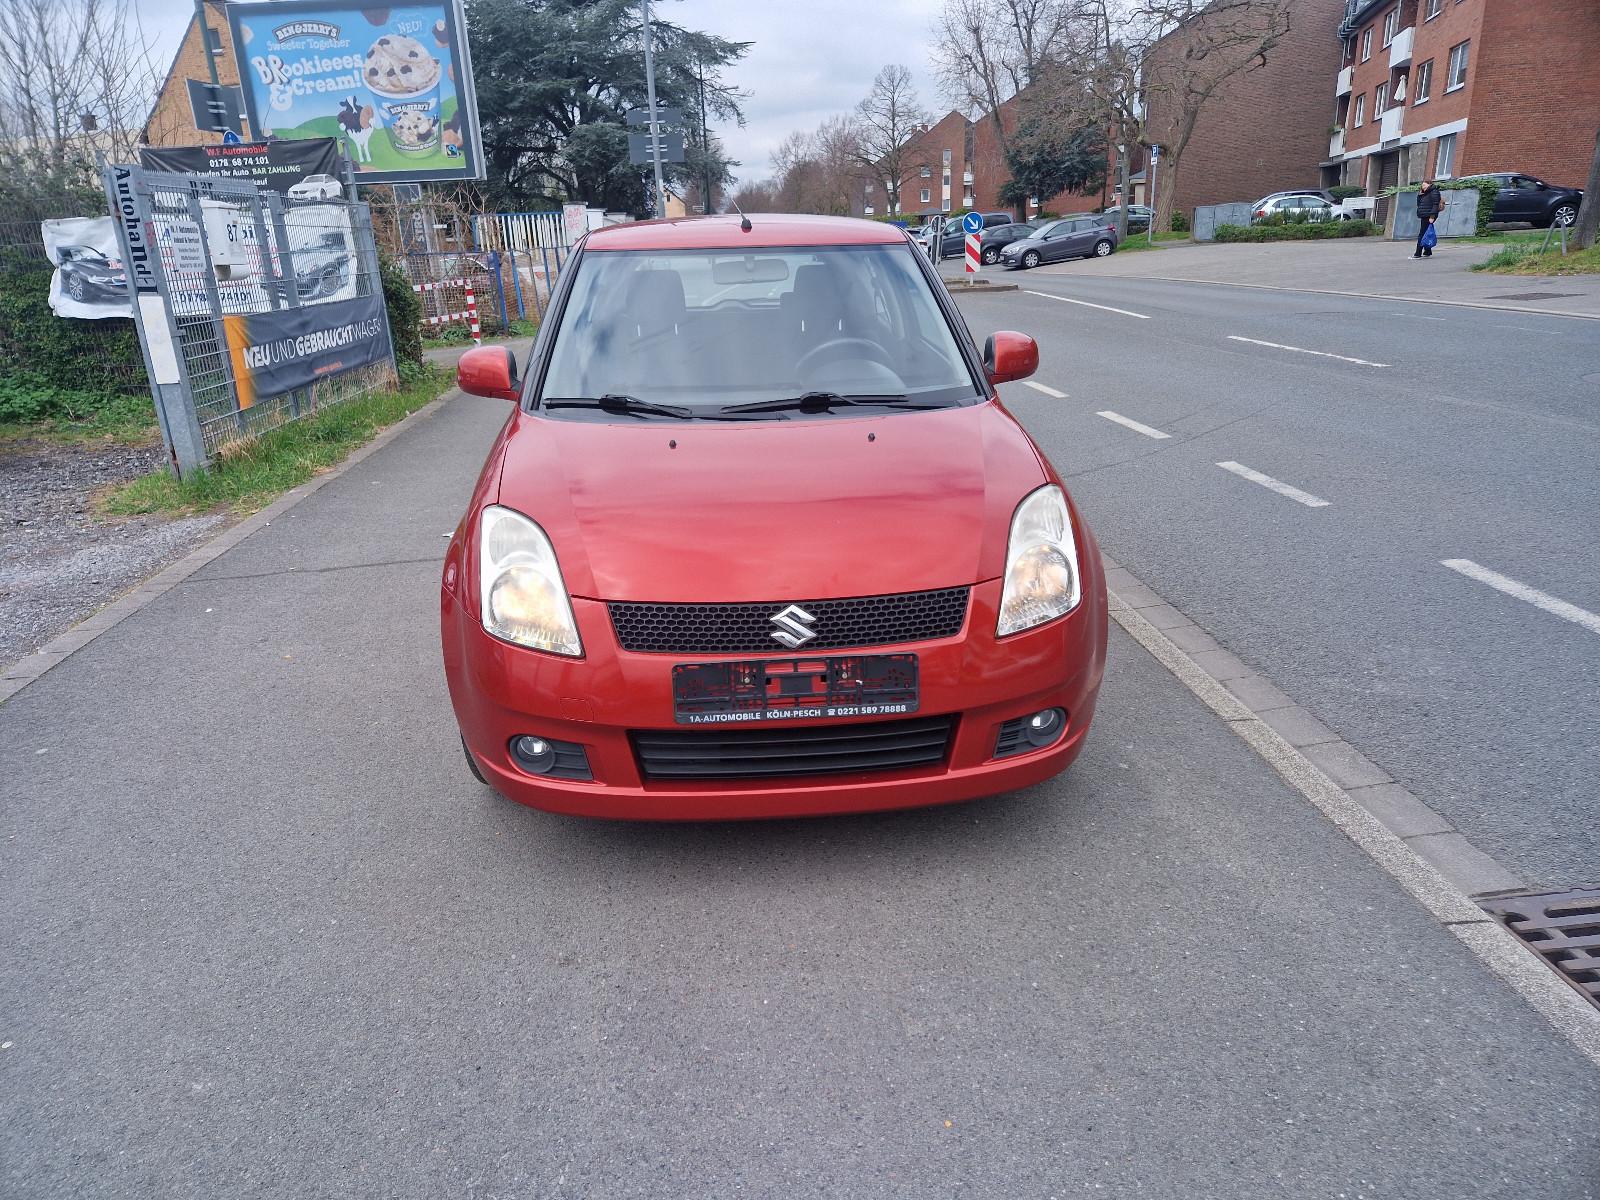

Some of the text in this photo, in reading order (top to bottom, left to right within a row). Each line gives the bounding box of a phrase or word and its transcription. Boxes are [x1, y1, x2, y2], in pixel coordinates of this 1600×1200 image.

[397, 20, 423, 34] NEU!
[266, 38, 350, 51] Sweeter Together
[292, 70, 362, 97] Cream!
[223, 145, 268, 155] Automobile
[209, 156, 270, 168] 0178 68 74 101
[233, 169, 250, 177] Auto
[252, 167, 267, 176] BAR
[268, 165, 301, 174] ZAHLUNG
[226, 223, 238, 242] 87
[689, 704, 907, 723] 1A-AUTOMOBILE KÖLN-PESCH 0221 589 78888
